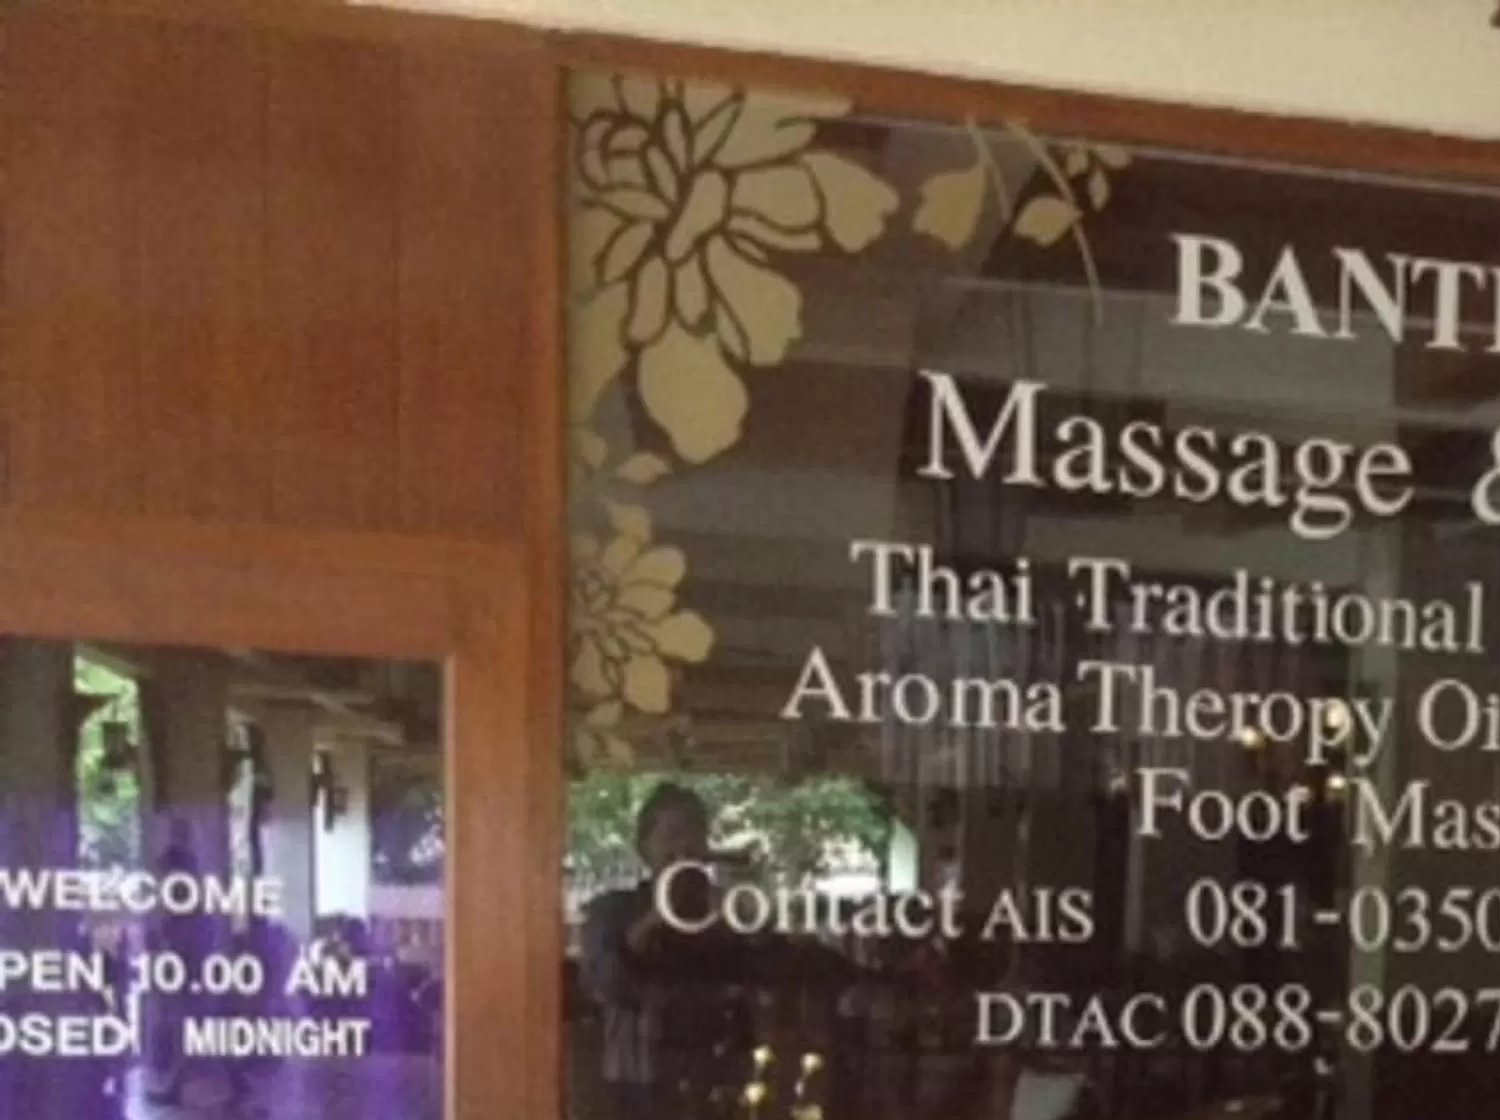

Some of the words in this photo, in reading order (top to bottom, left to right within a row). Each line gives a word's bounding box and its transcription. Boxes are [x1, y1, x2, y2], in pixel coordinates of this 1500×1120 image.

[915, 368, 1415, 540] Massage
[849, 537, 1036, 628] Thai
[1067, 557, 1485, 653] Traditional
[780, 645, 1066, 734] Aroma
[1076, 658, 1394, 768] Theropy
[1135, 767, 1312, 844] Foot
[0, 869, 284, 917] WELCOME
[654, 859, 964, 938] Contact
[979, 887, 1097, 944] AIS
[135, 953, 264, 995] 10.00
[284, 955, 367, 998] AM
[183, 1016, 372, 1059] MIDNIGHT
[973, 990, 1170, 1052] DTAC
